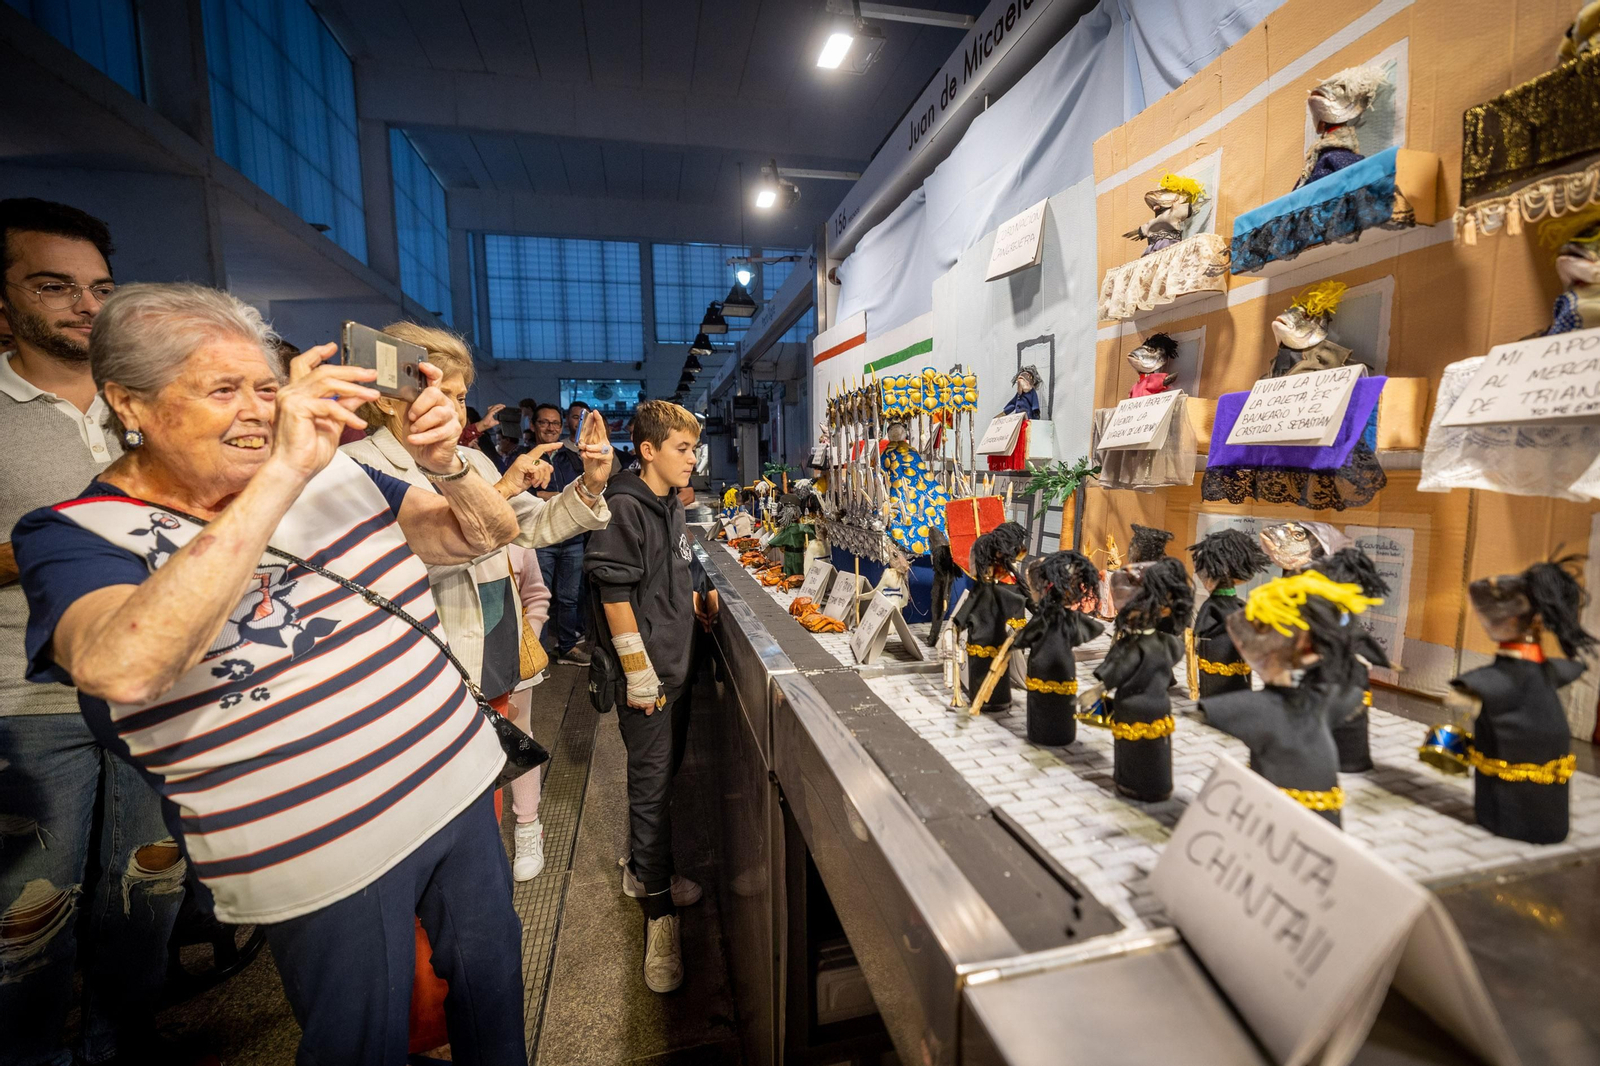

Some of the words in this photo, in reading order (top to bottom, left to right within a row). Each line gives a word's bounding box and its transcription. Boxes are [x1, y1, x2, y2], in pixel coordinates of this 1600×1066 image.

[908, 103, 935, 151] Juan
[940, 73, 957, 111] de
[835, 207, 847, 238] 156
[1496, 349, 1524, 366] MI
[1292, 376, 1310, 389] LA
[1480, 374, 1508, 391] AL
[1525, 358, 1600, 383] MERCA
[1249, 399, 1262, 410] LA
[1267, 391, 1308, 406] CALETA,
[1467, 396, 1499, 416] DE
[1137, 411, 1148, 422] LA
[1242, 407, 1291, 425] BALNEARIO
[1298, 406, 1305, 416] Y
[1307, 403, 1323, 413] EL
[1235, 422, 1272, 437] CASTILLO
[1201, 779, 1339, 912] CHINTA,
[1185, 830, 1336, 990] CHINTA!!
